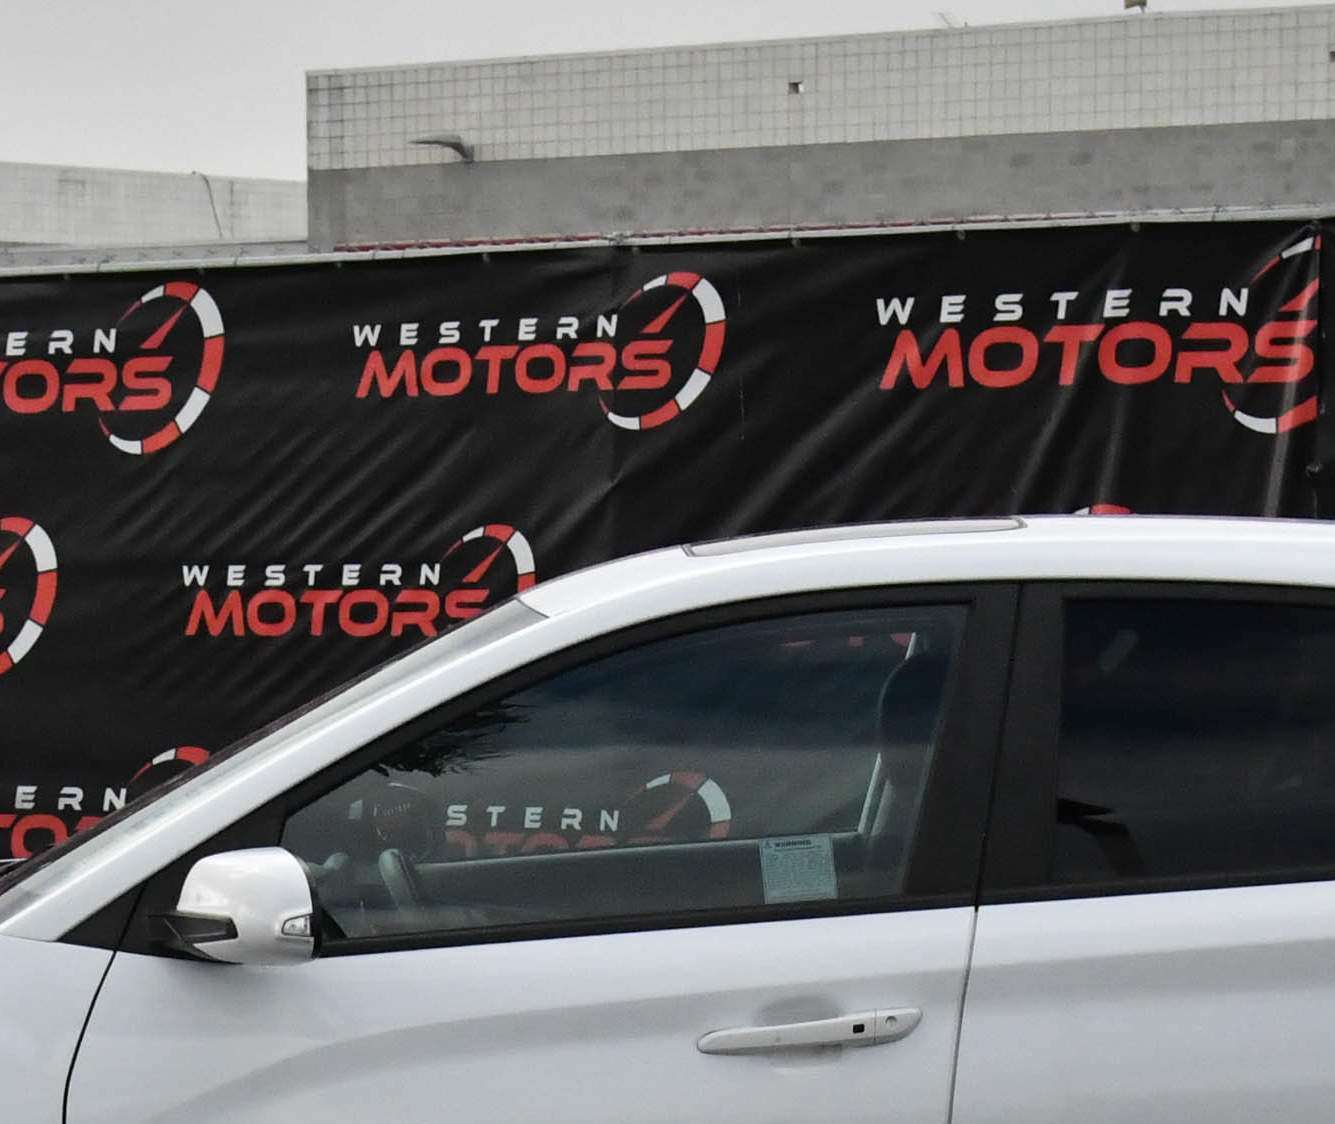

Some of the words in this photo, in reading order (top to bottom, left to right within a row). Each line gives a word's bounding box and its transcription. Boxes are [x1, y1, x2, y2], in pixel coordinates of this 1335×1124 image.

[877, 288, 1248, 325] WESTERN
[354, 315, 617, 346] WESTERN
[357, 339, 672, 398] MOTORS
[880, 320, 1317, 389] MOTORS
[183, 564, 440, 586] WESTERN
[186, 588, 489, 637] MOTORS
[447, 805, 618, 831] STERN
